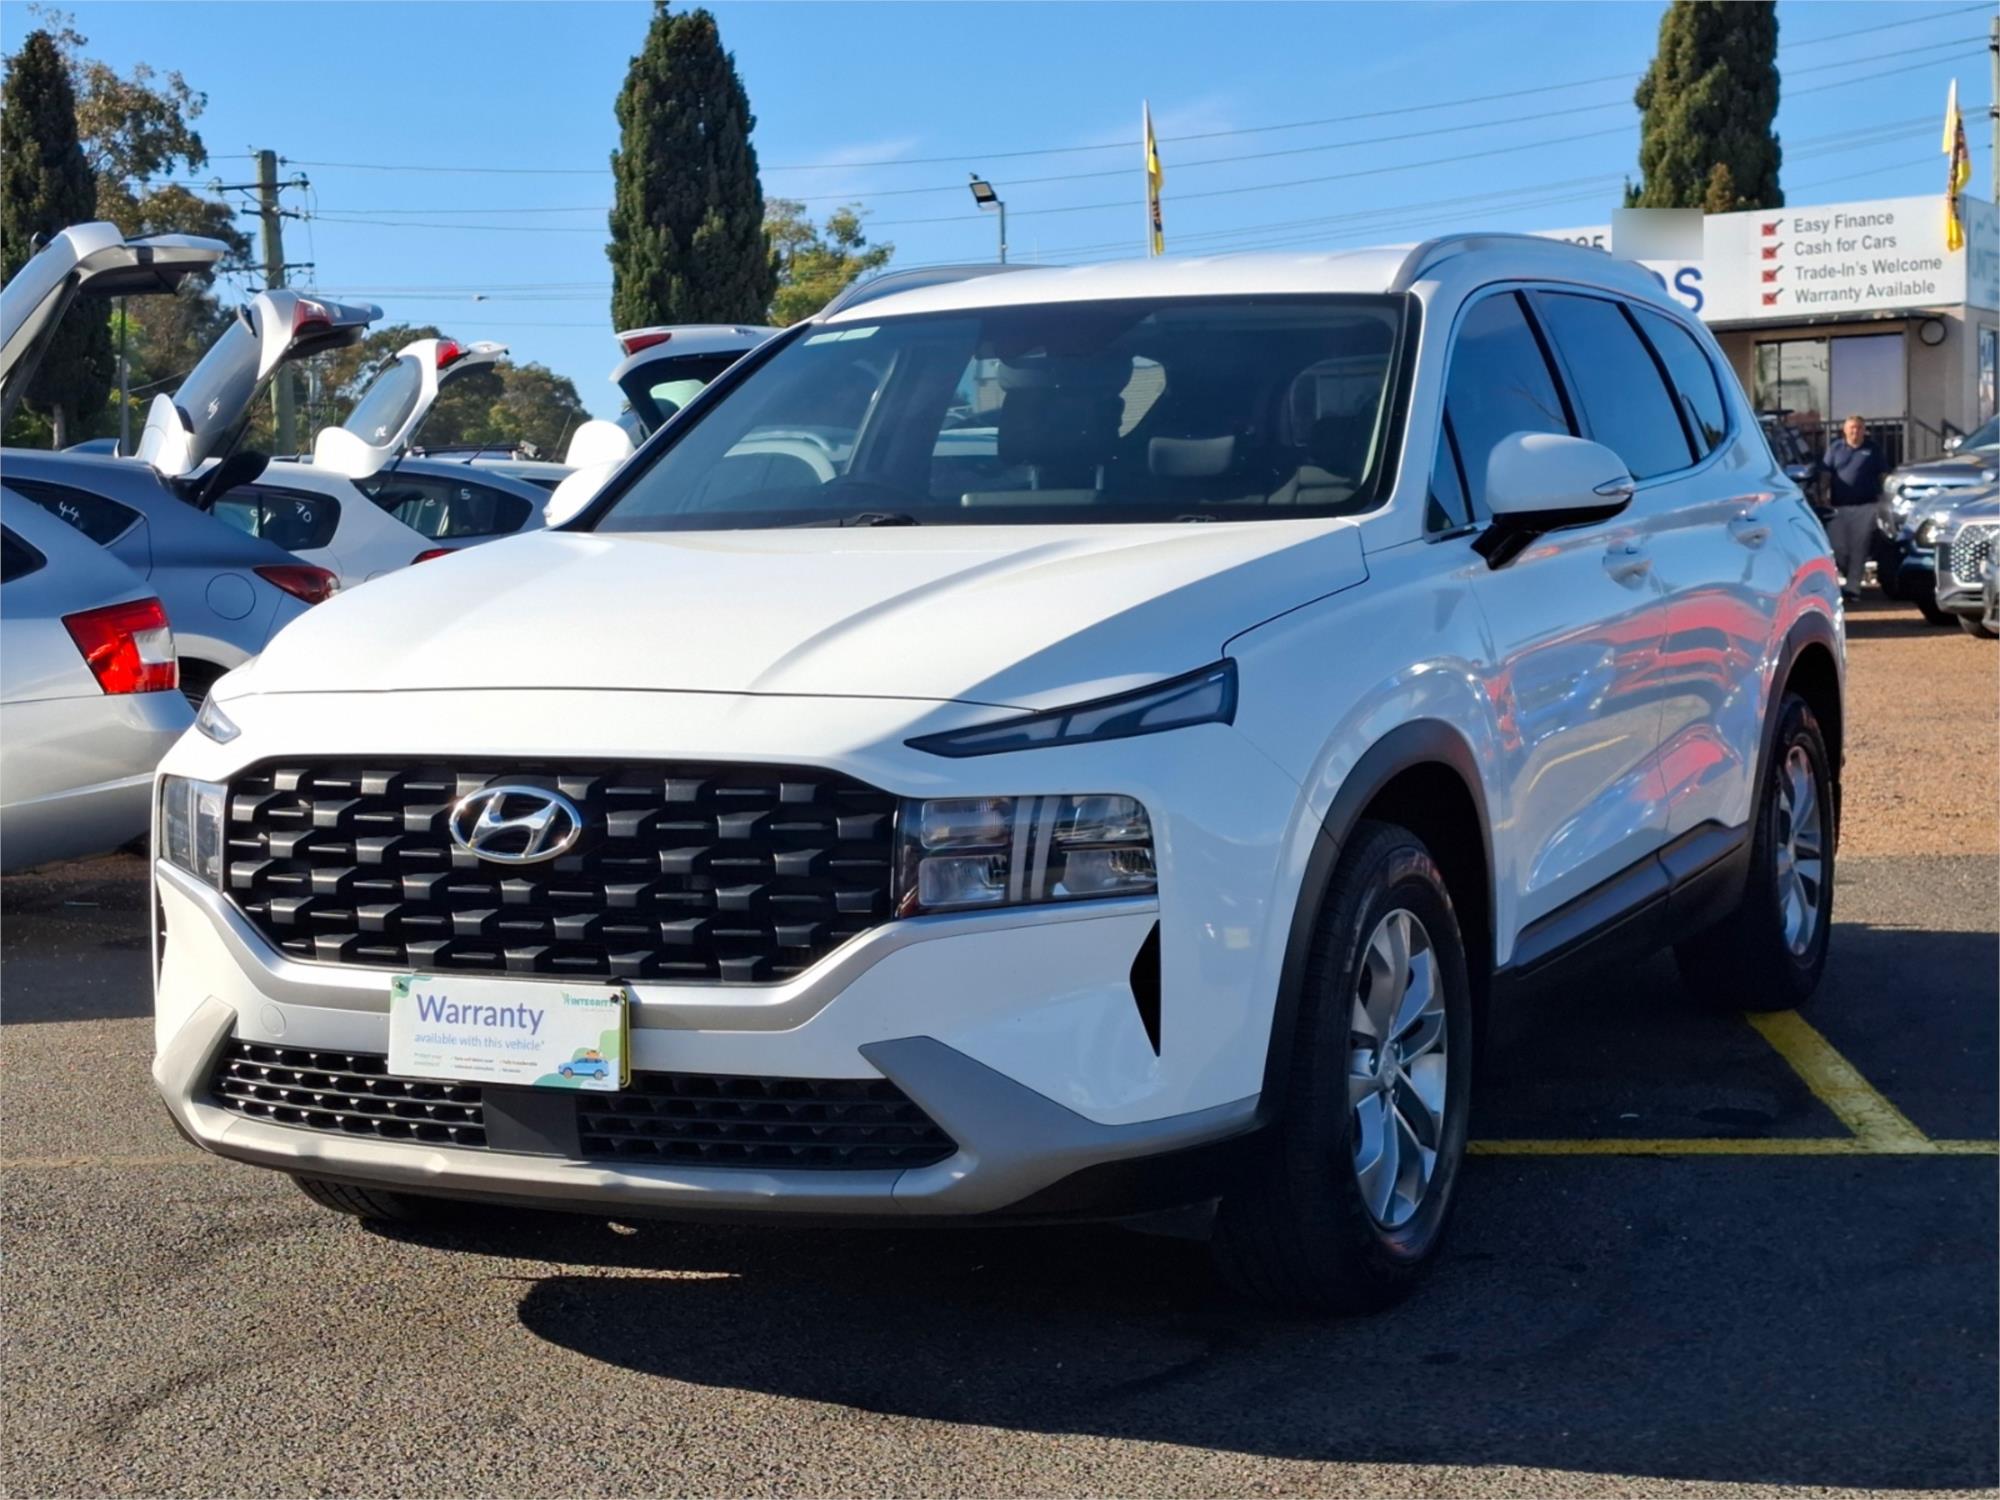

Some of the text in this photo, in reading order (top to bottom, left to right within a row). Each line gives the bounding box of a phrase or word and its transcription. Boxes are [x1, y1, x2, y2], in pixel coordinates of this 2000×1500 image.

[1794, 212, 1894, 234] Easy Finance
[1794, 235, 1897, 256] Cash for Cars
[1795, 257, 1943, 280] Trade-In's Welcome
[1795, 279, 1936, 303] Warranty Available
[416, 993, 545, 1035] Warranty
[414, 1032, 457, 1046] available
[460, 1036, 481, 1048] with
[484, 1038, 502, 1049] this
